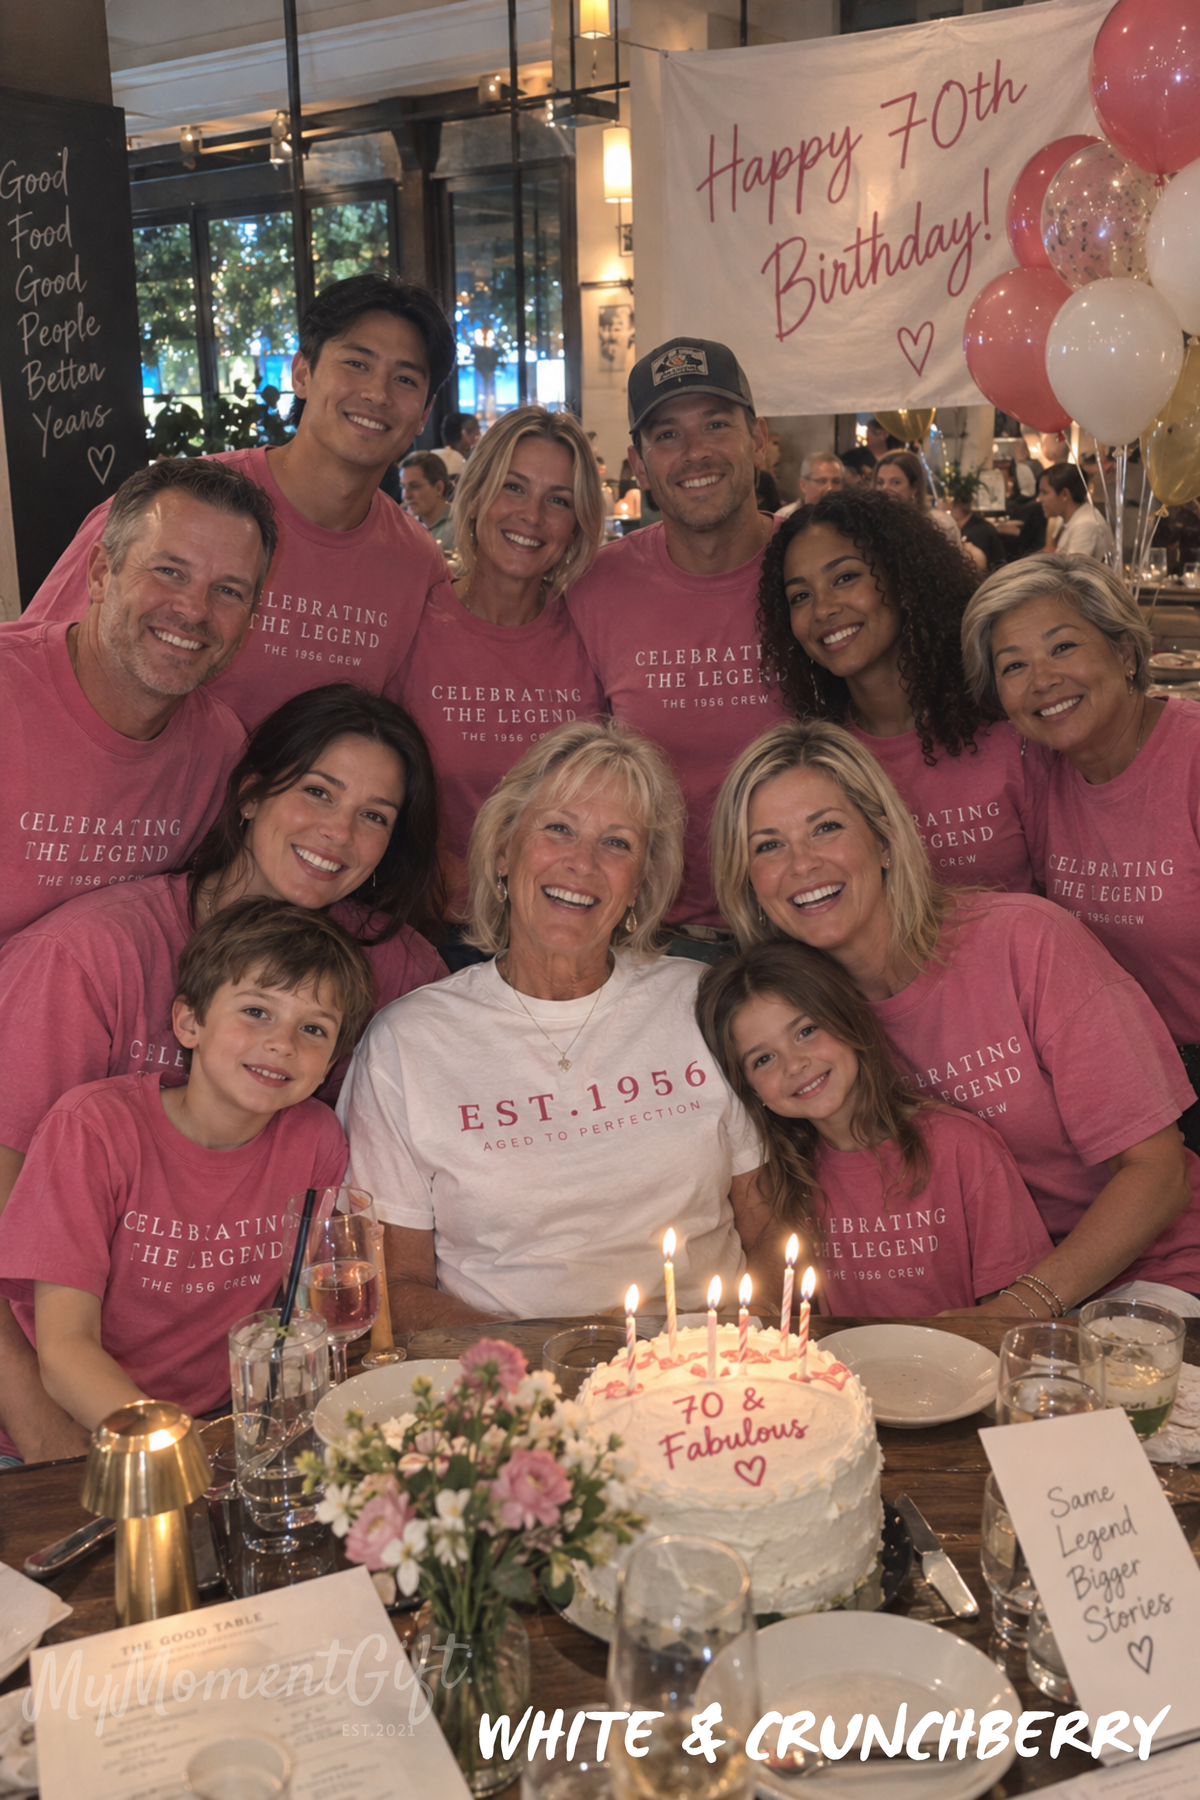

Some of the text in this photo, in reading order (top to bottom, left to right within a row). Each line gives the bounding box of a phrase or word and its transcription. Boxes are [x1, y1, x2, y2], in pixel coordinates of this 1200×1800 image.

[696, 59, 1028, 225] Happy 70th
[0, 147, 69, 204] Good
[7, 205, 73, 259] Food
[761, 167, 992, 342] Birthday!
[15, 254, 88, 307] Good
[17, 302, 101, 355] People
[258, 590, 388, 627] LEBRATING
[248, 613, 380, 648] THE LEGEND
[264, 643, 361, 666] THE 1956 CREW
[635, 643, 794, 667] CELEBRATI
[431, 685, 581, 702] CELEBRATING
[645, 673, 686, 688] THE
[662, 694, 769, 709] THE 1956 CREW
[443, 707, 577, 724] THE LEGEND
[462, 732, 486, 742] THE
[494, 733, 523, 742] 1956
[20, 812, 181, 836] CELEBRATING
[912, 802, 1000, 828] RATING
[25, 842, 169, 863] THE LEGEND
[940, 854, 977, 867] CREW
[37, 875, 64, 887] THE
[70, 875, 101, 886] 1956
[1053, 879, 1163, 902] THE LEGEND
[1087, 912, 1110, 923] 1956
[1114, 914, 1145, 925] CREW
[941, 1066, 1021, 1105] EGEND
[977, 1102, 1008, 1119] REW
[483, 1100, 702, 1151] AGED TO PERFECTION
[814, 1235, 939, 1259] HE LEGEND
[141, 1274, 261, 1294] THE 1956 CREW
[826, 1266, 925, 1280] THE 1956 CREW
[672, 1387, 766, 1425] 70 &
[658, 1416, 810, 1470] Fabulous
[1047, 1485, 1115, 1518] Same
[1056, 1504, 1139, 1561] Legend
[1066, 1560, 1141, 1602] Bigger
[1083, 1592, 1174, 1643] Stories
[120, 1640, 154, 1656] THE
[160, 1627, 208, 1647] GOOD
[213, 1612, 264, 1633] TABLE
